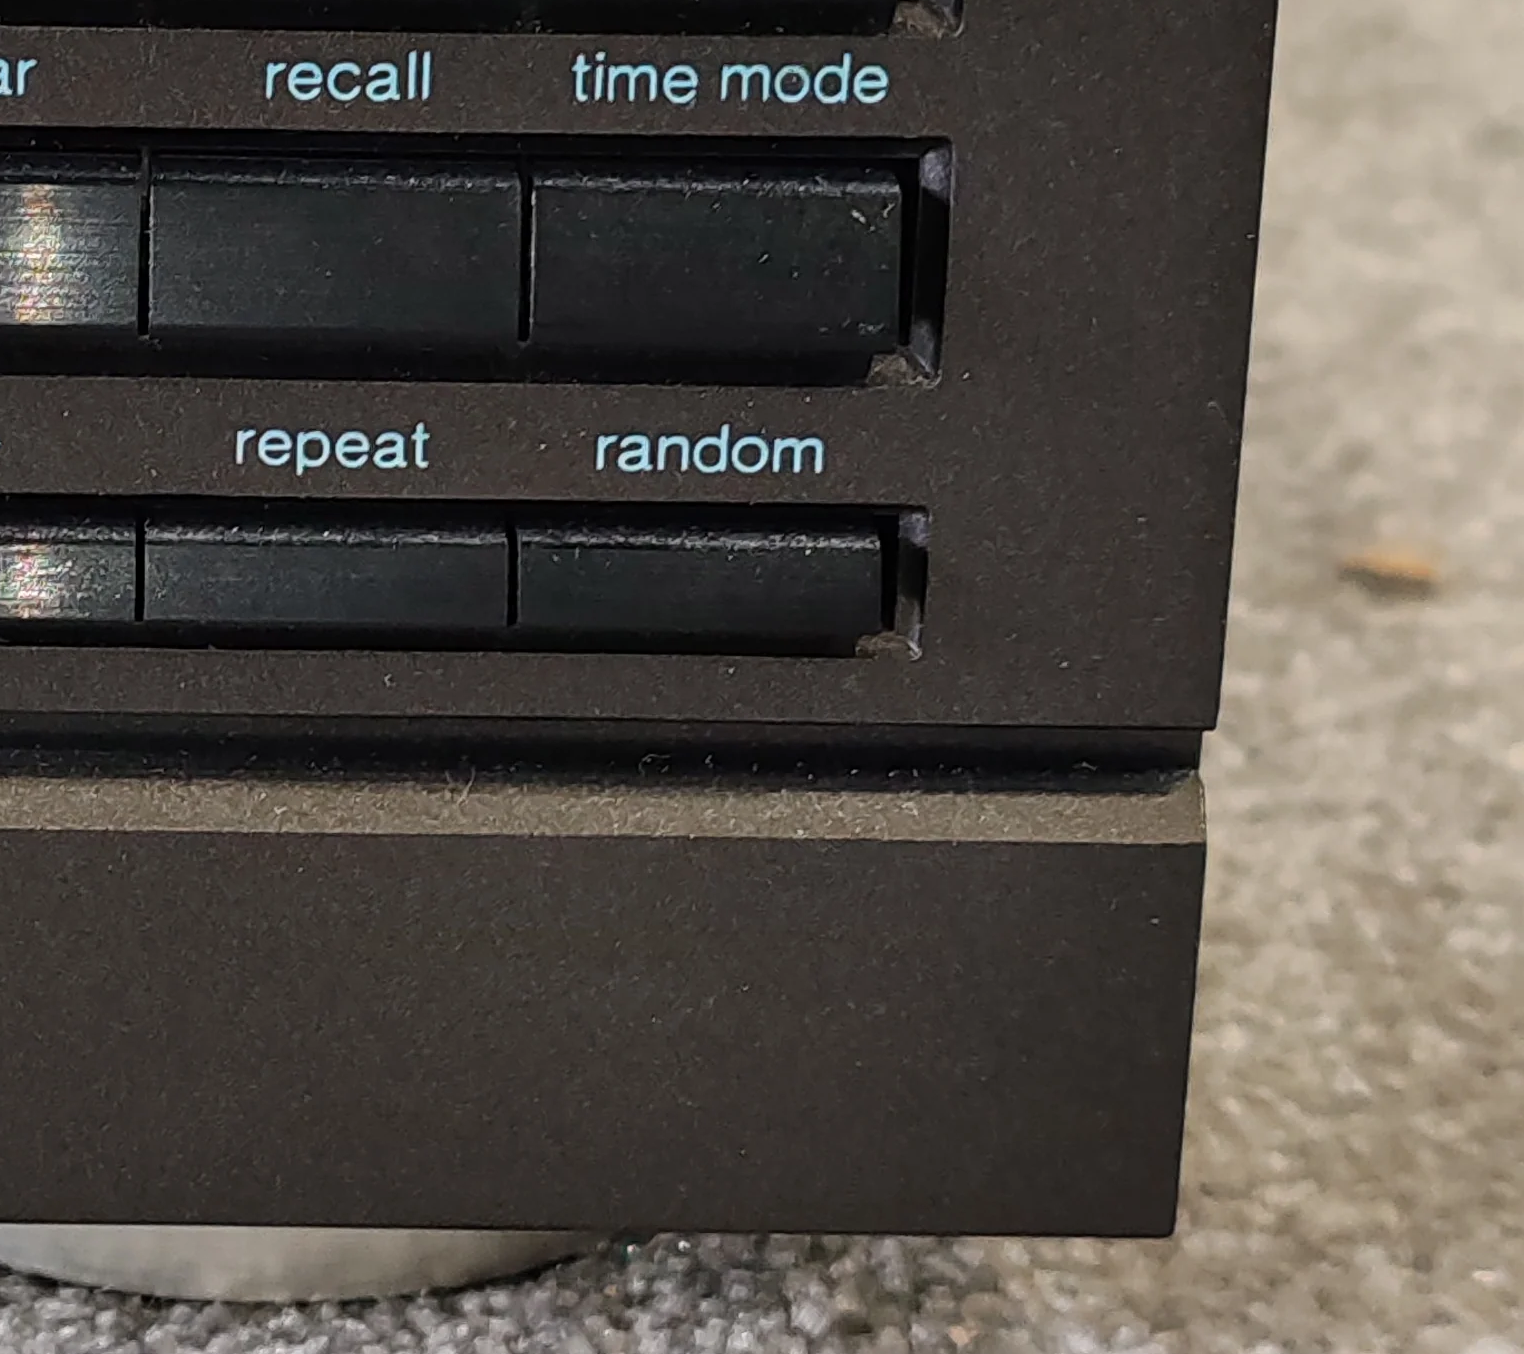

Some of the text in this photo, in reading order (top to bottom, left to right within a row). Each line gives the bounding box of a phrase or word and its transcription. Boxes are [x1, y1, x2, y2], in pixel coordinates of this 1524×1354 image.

[265, 50, 431, 102] recall
[571, 51, 889, 104] time mode
[235, 422, 431, 476] repeat
[596, 423, 824, 474] random
